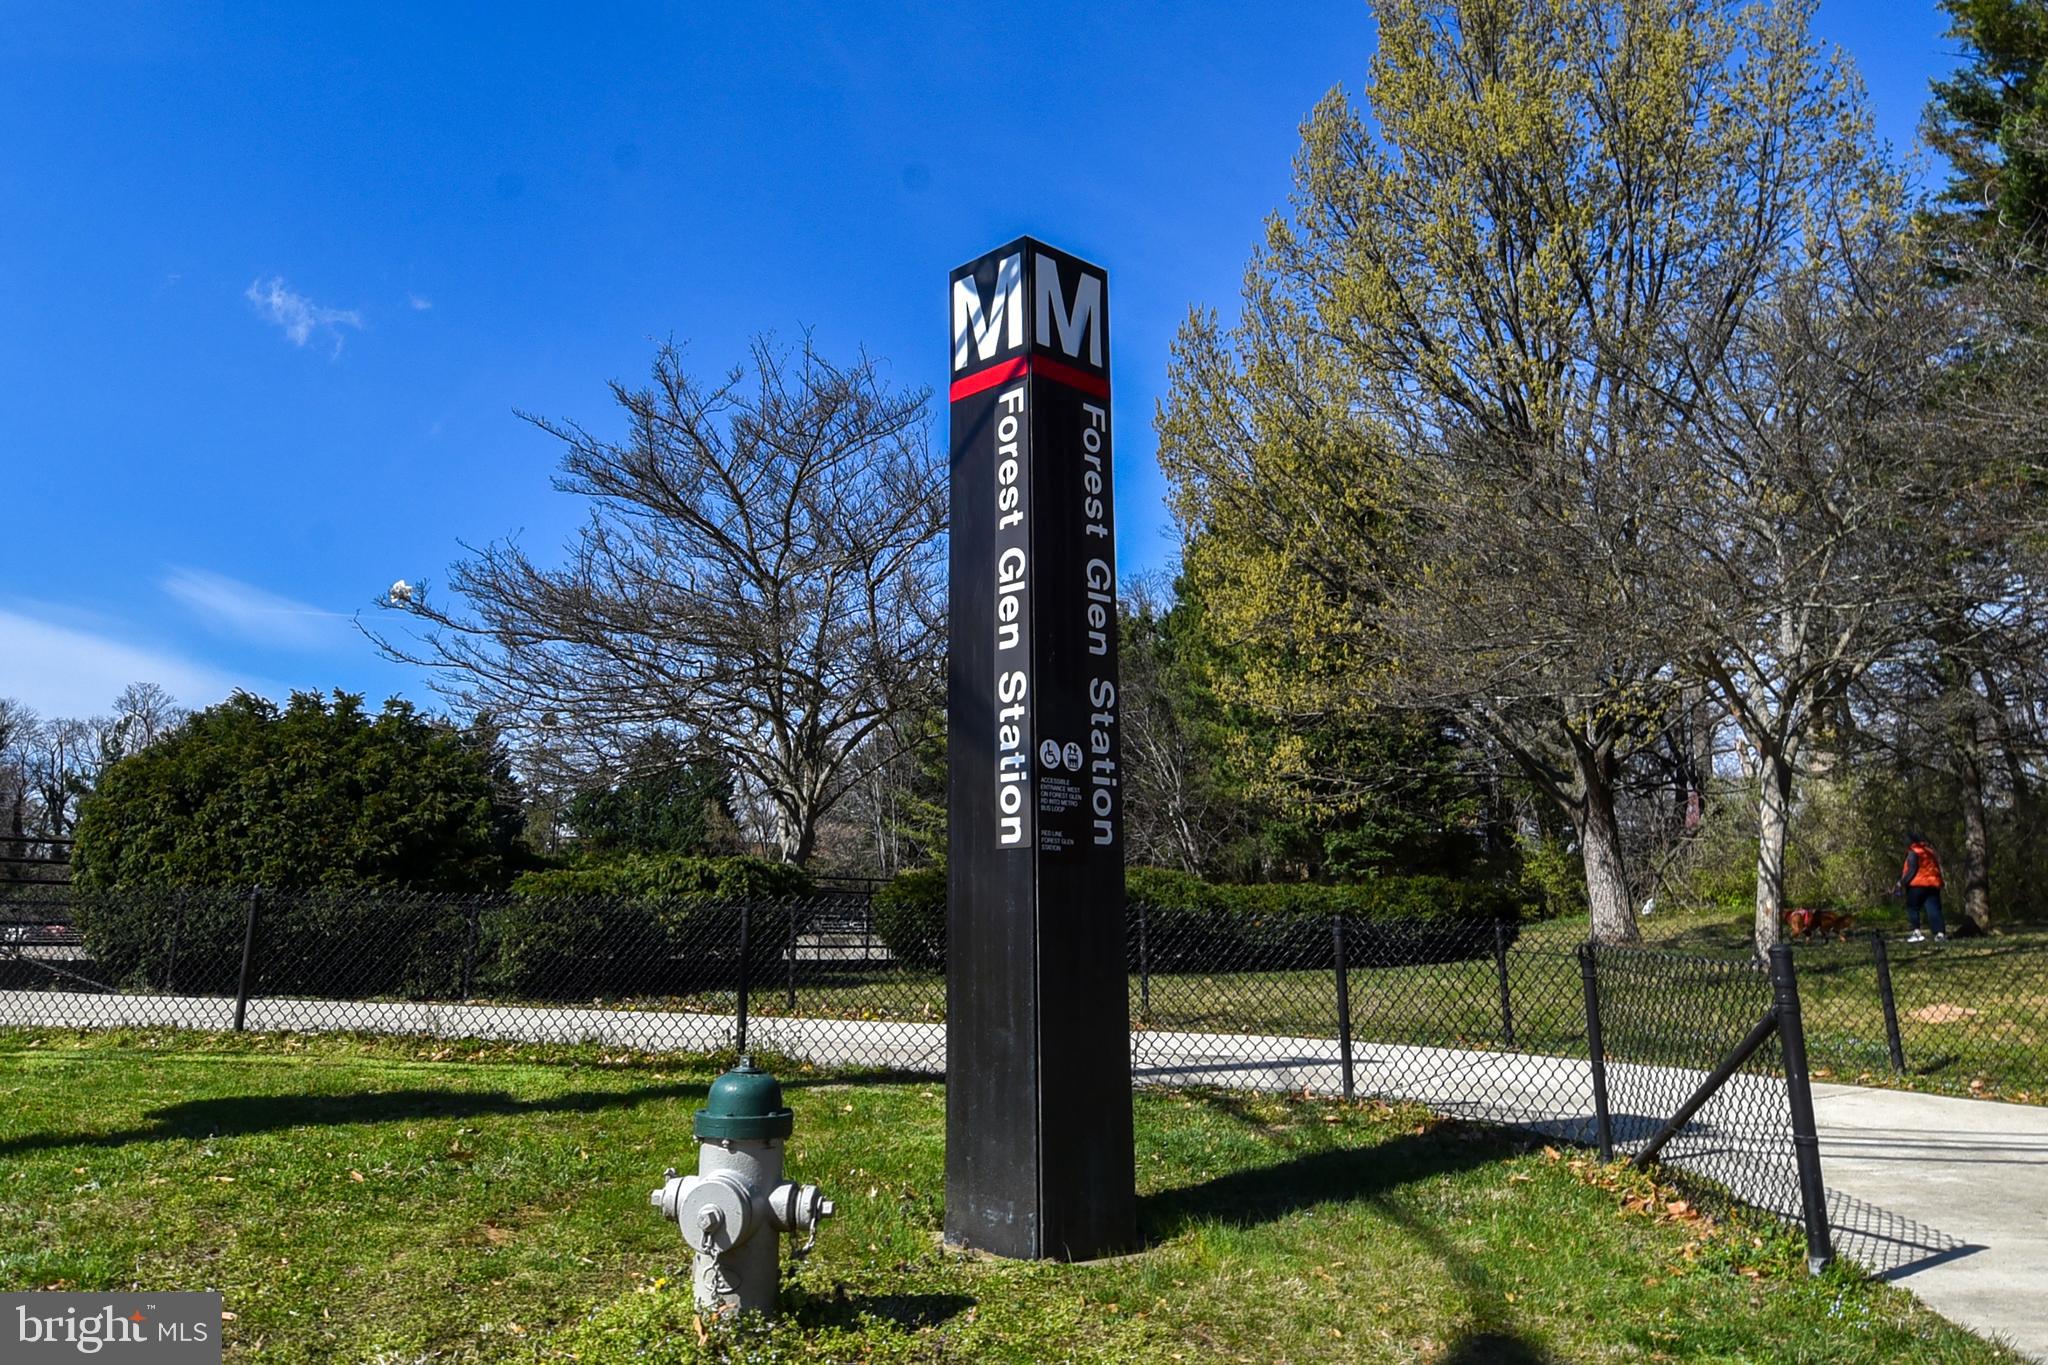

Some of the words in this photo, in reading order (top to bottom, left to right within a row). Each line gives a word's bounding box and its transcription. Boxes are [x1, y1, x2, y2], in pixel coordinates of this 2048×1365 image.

[954, 252, 1023, 372] M
[1035, 252, 1103, 369] M
[997, 386, 1024, 530] Forest
[1083, 402, 1108, 539] Forest
[998, 547, 1026, 650] Glen
[1086, 558, 1112, 656] Glen
[998, 672, 1027, 845] Station
[1041, 777, 1070, 786] ACCESSIBLE
[1041, 784, 1066, 792] ENTRANCE
[1089, 677, 1117, 846] Station
